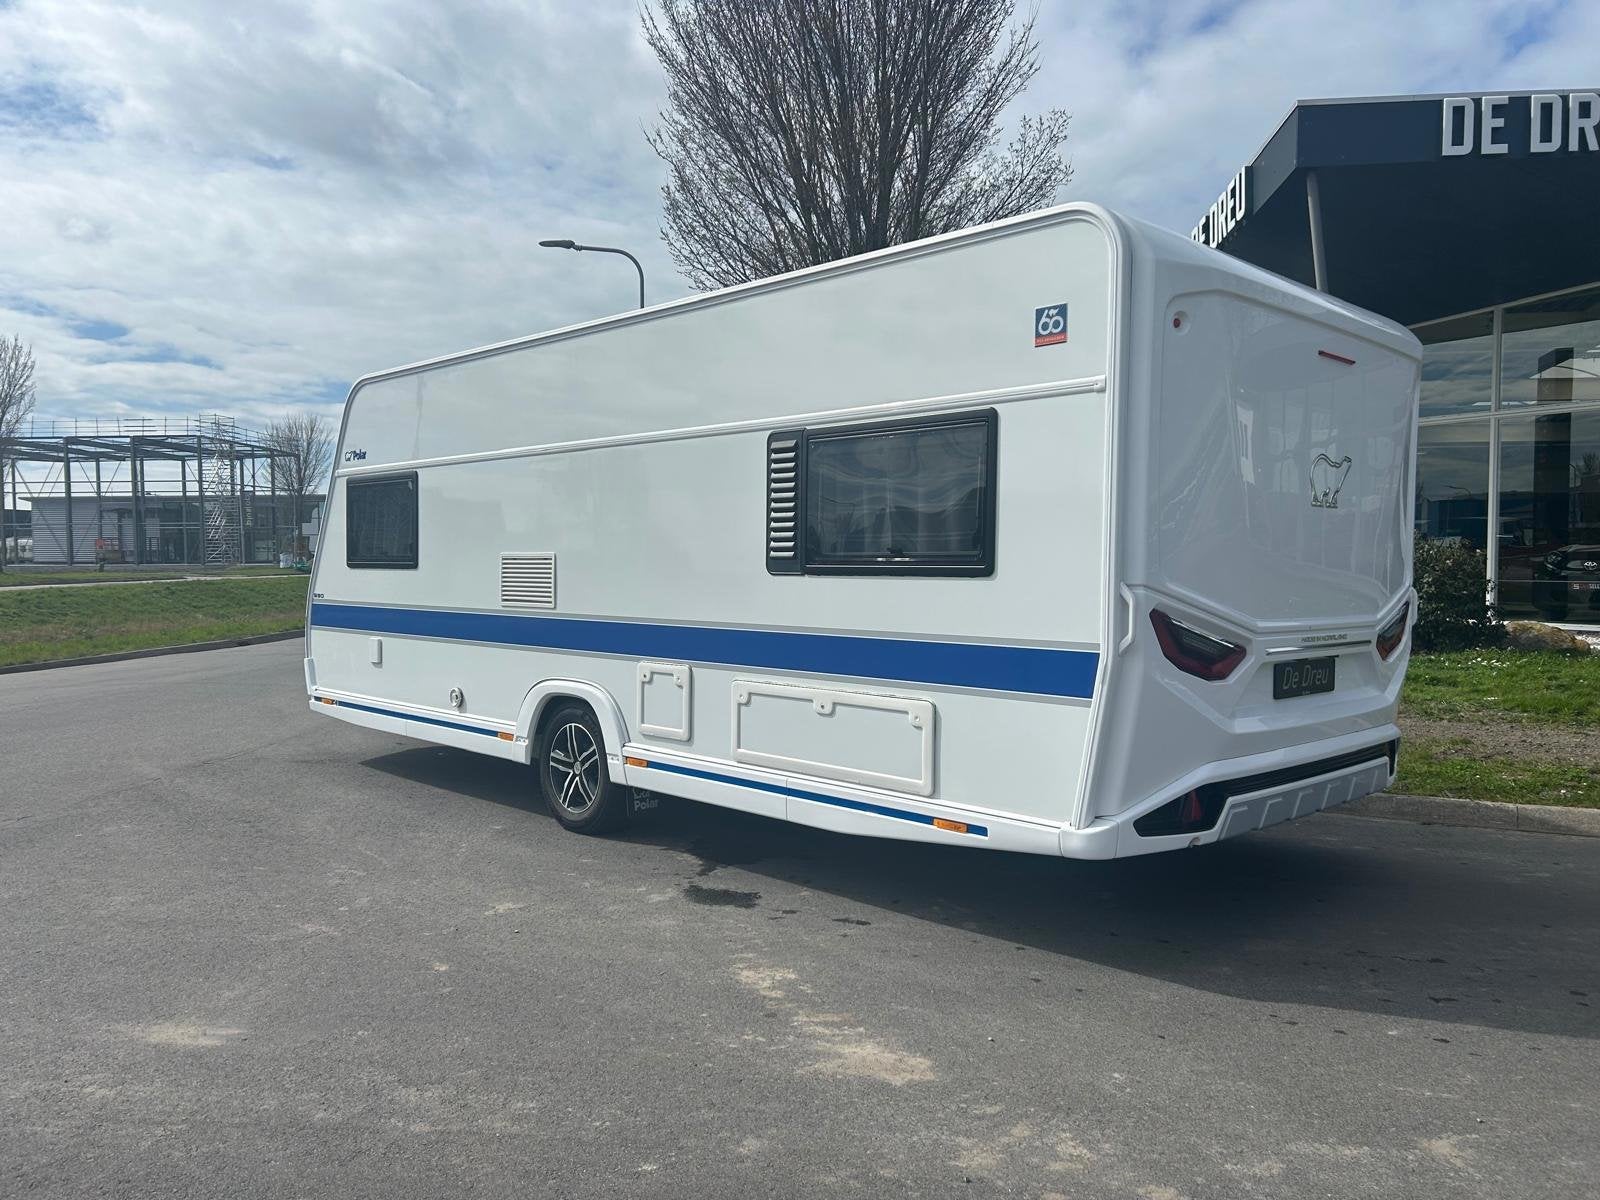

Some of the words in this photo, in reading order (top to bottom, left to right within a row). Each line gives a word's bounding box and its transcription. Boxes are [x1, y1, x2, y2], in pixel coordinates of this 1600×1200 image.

[1442, 95, 1509, 156] DE
[1209, 165, 1246, 249] DREU
[1282, 667, 1300, 690] De
[1302, 664, 1329, 687] Dreu
[634, 798, 658, 812] Polar
